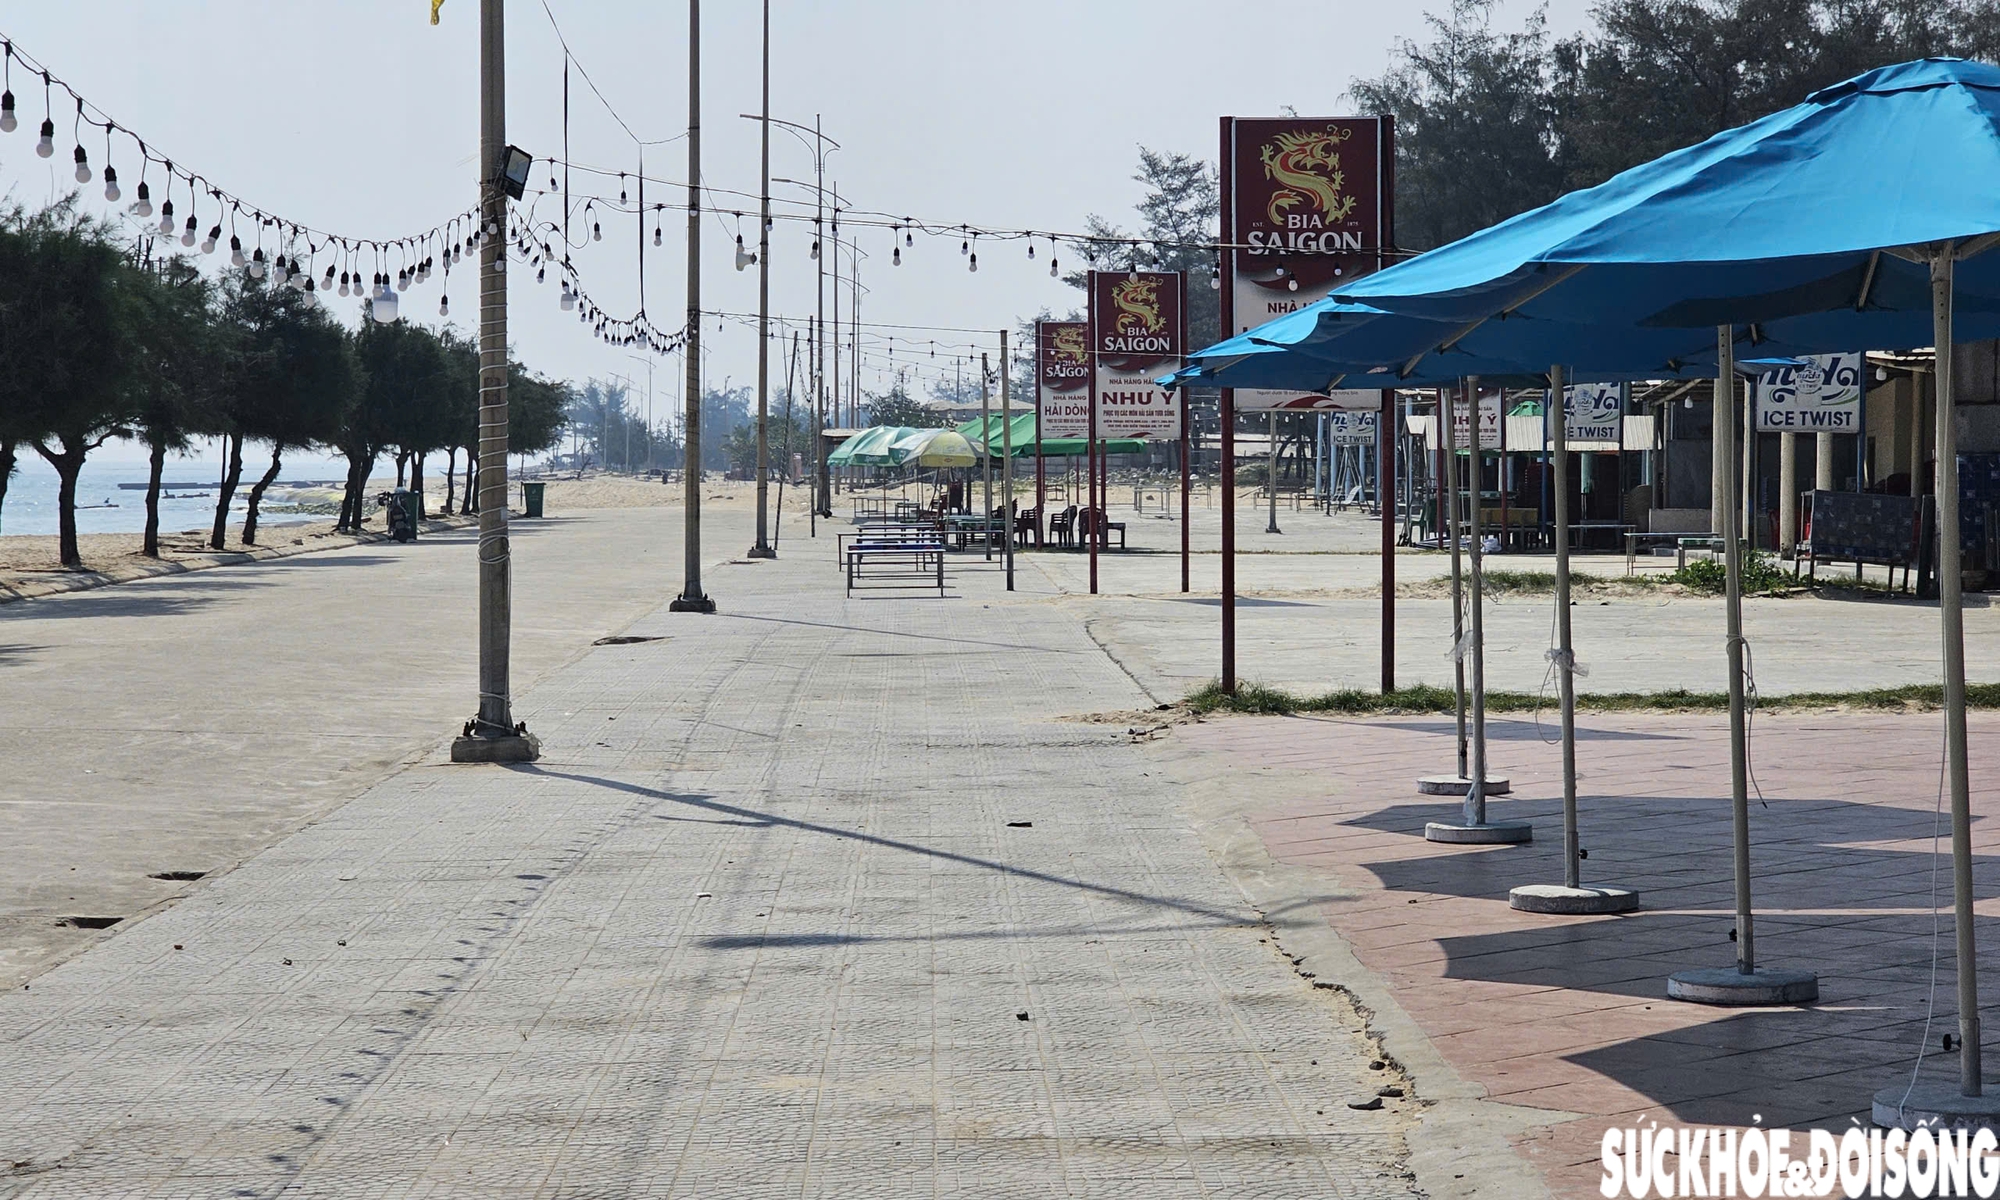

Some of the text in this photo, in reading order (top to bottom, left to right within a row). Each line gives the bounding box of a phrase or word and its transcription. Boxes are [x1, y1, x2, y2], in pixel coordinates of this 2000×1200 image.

[1287, 214, 1323, 229] BIA
[1247, 231, 1363, 255] SAIGON
[1127, 327, 1148, 336] BIA
[1104, 337, 1170, 351] SAIGON
[1109, 377, 1122, 385] NHÀ
[1124, 377, 1142, 385] HÀNG
[1102, 390, 1154, 405] NHƯ
[1045, 402, 1089, 416] HẢI DÒN
[1487, 413, 1497, 425] Ý
[1763, 410, 1853, 426] ICE TWIST
[1333, 435, 1372, 443] ICE TWIST
[1577, 426, 1615, 438] TWIST
